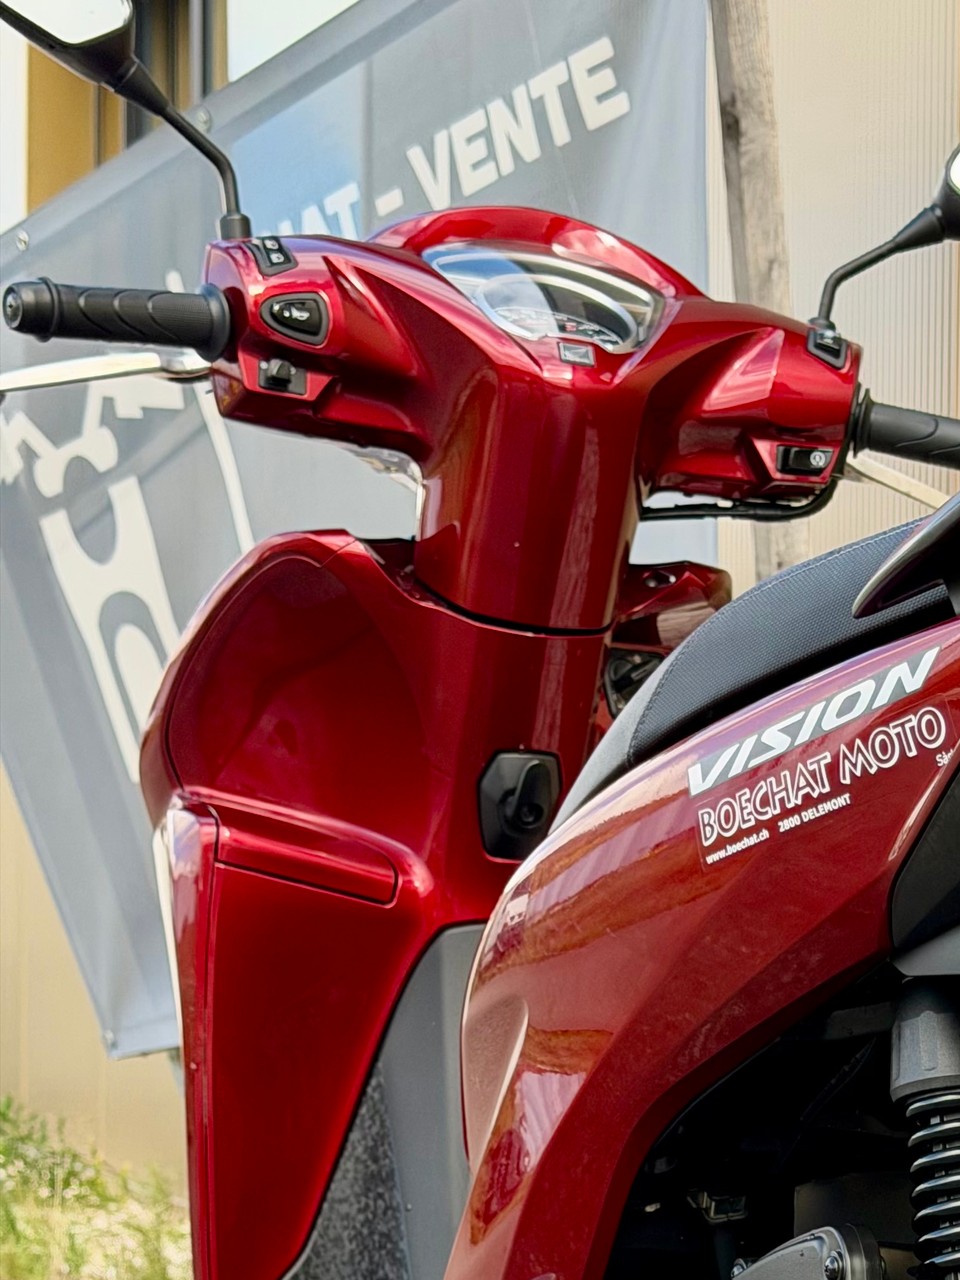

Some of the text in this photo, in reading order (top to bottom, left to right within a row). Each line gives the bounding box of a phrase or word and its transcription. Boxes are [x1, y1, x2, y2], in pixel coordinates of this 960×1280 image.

[406, 36, 631, 210] VENTE
[687, 646, 940, 797] VISION
[698, 706, 946, 847] BOECHAT MOTO
[705, 793, 851, 865] www.boechat.ch 2800 DELEMONT
